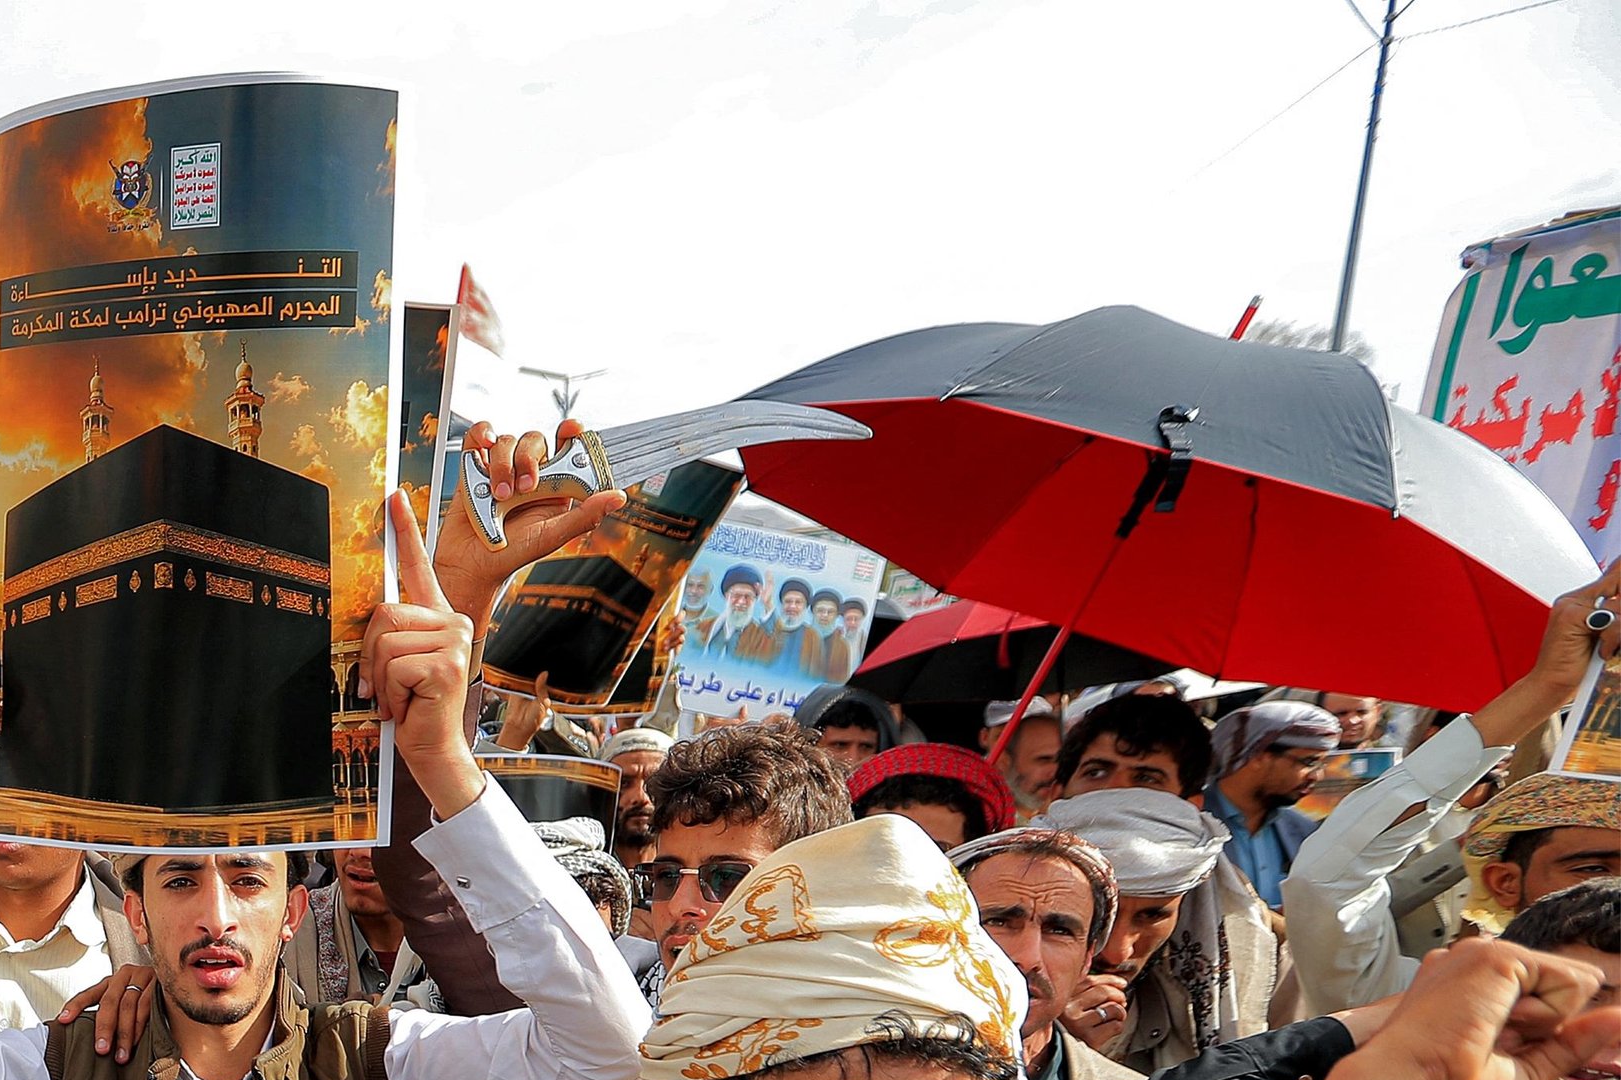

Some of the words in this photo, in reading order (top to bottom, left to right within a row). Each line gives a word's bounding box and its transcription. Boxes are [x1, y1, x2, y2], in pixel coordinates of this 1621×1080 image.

[200, 150, 217, 164] الله
[69, 306, 110, 329] لمكة
[115, 301, 168, 331] ترامب
[172, 295, 274, 330] الصهيوني
[279, 294, 341, 322] المجرم
[10, 311, 64, 340] المكرمة
[726, 680, 764, 703] على
